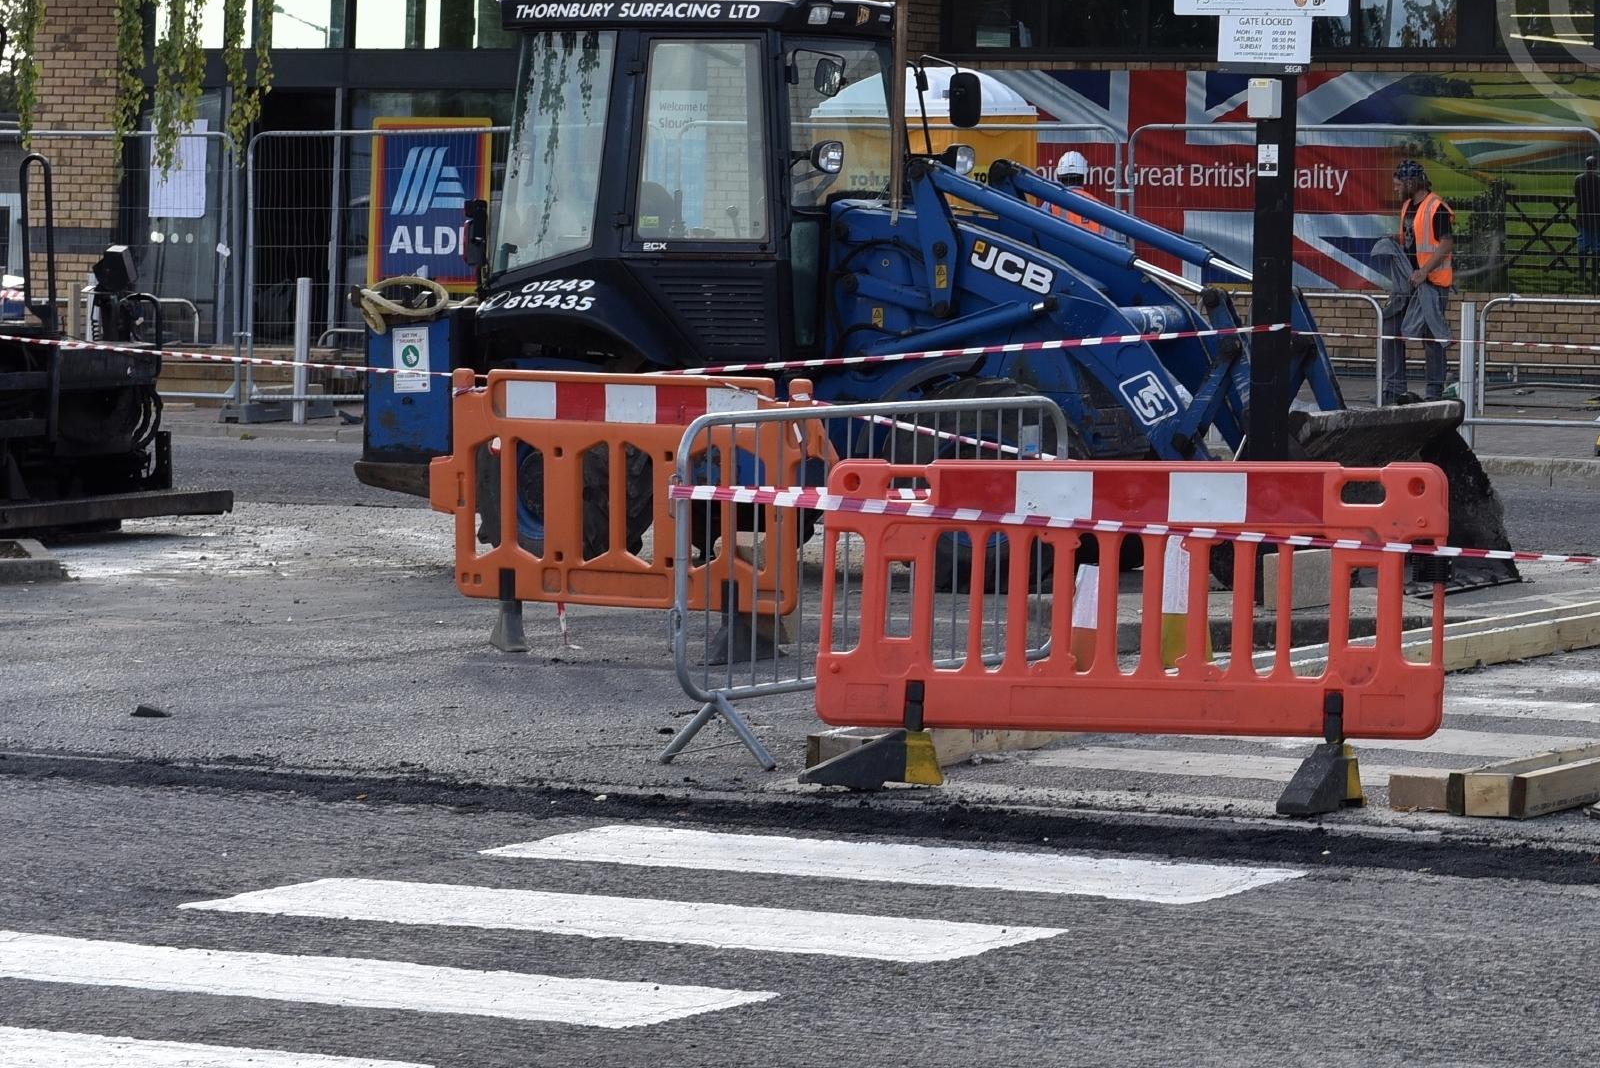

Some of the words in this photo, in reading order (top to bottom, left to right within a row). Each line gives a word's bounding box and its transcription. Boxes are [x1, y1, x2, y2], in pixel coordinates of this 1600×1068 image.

[515, 2, 615, 19] THORNBURY
[618, 2, 721, 19] SURFACING
[728, 4, 760, 19] LTD
[1238, 17, 1261, 26] GATE
[1261, 18, 1293, 26] LOCKED
[659, 101, 698, 112] Welcome
[1124, 162, 1185, 187] Great
[1189, 161, 1256, 188] British
[1265, 163, 1270, 171] 2
[970, 240, 1054, 295] JCB
[521, 278, 596, 294] 01249
[503, 294, 597, 311] 813435
